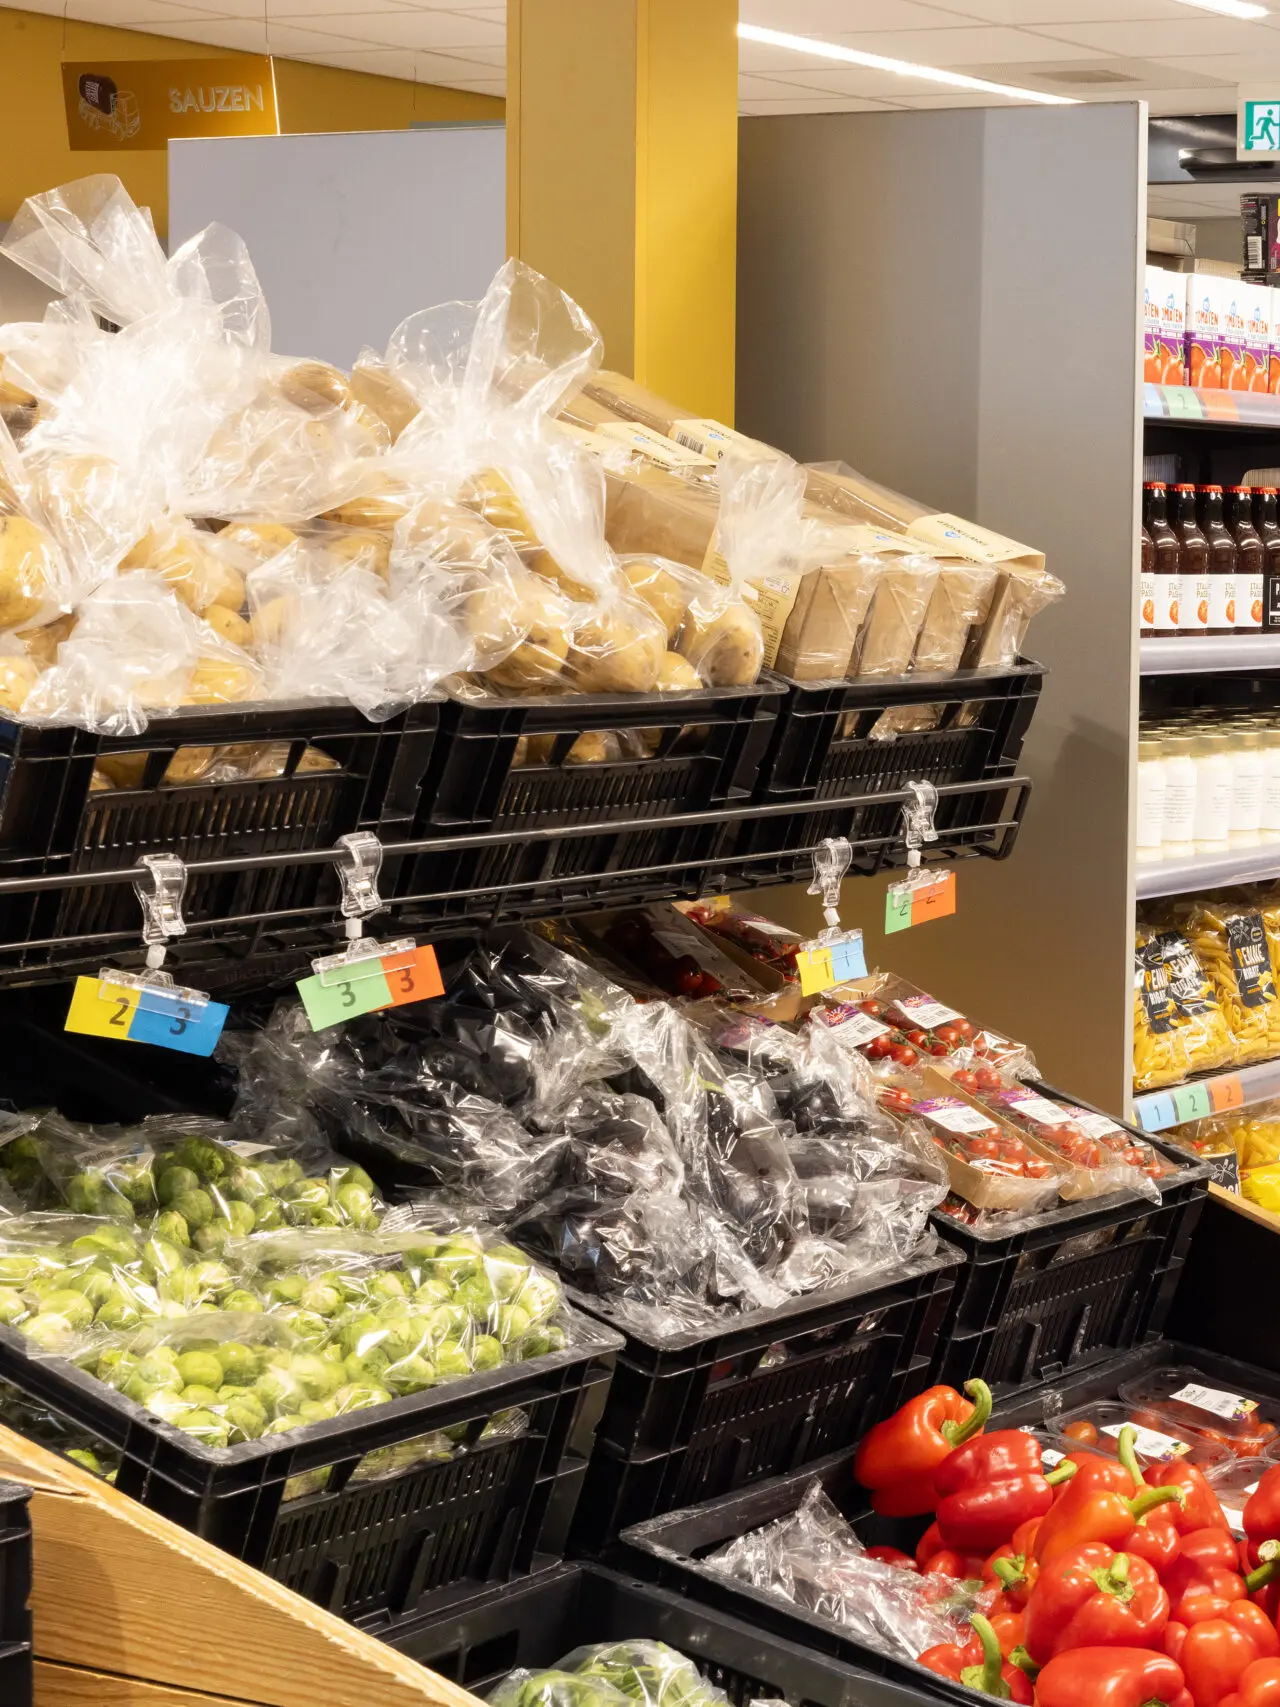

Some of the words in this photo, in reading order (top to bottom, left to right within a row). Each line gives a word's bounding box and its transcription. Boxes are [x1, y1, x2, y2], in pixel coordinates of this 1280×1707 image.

[169, 84, 264, 114] SAUZEN
[899, 900, 910, 916] 2
[926, 887, 936, 904] 2
[1236, 943, 1265, 968] PENNE
[401, 967, 415, 993] 3
[340, 981, 356, 1008] 3
[109, 997, 130, 1026] 2
[169, 1007, 190, 1035] 3
[1154, 1105, 1162, 1121] 1
[1189, 1094, 1198, 1112] 2
[1225, 1086, 1232, 1102] 2
